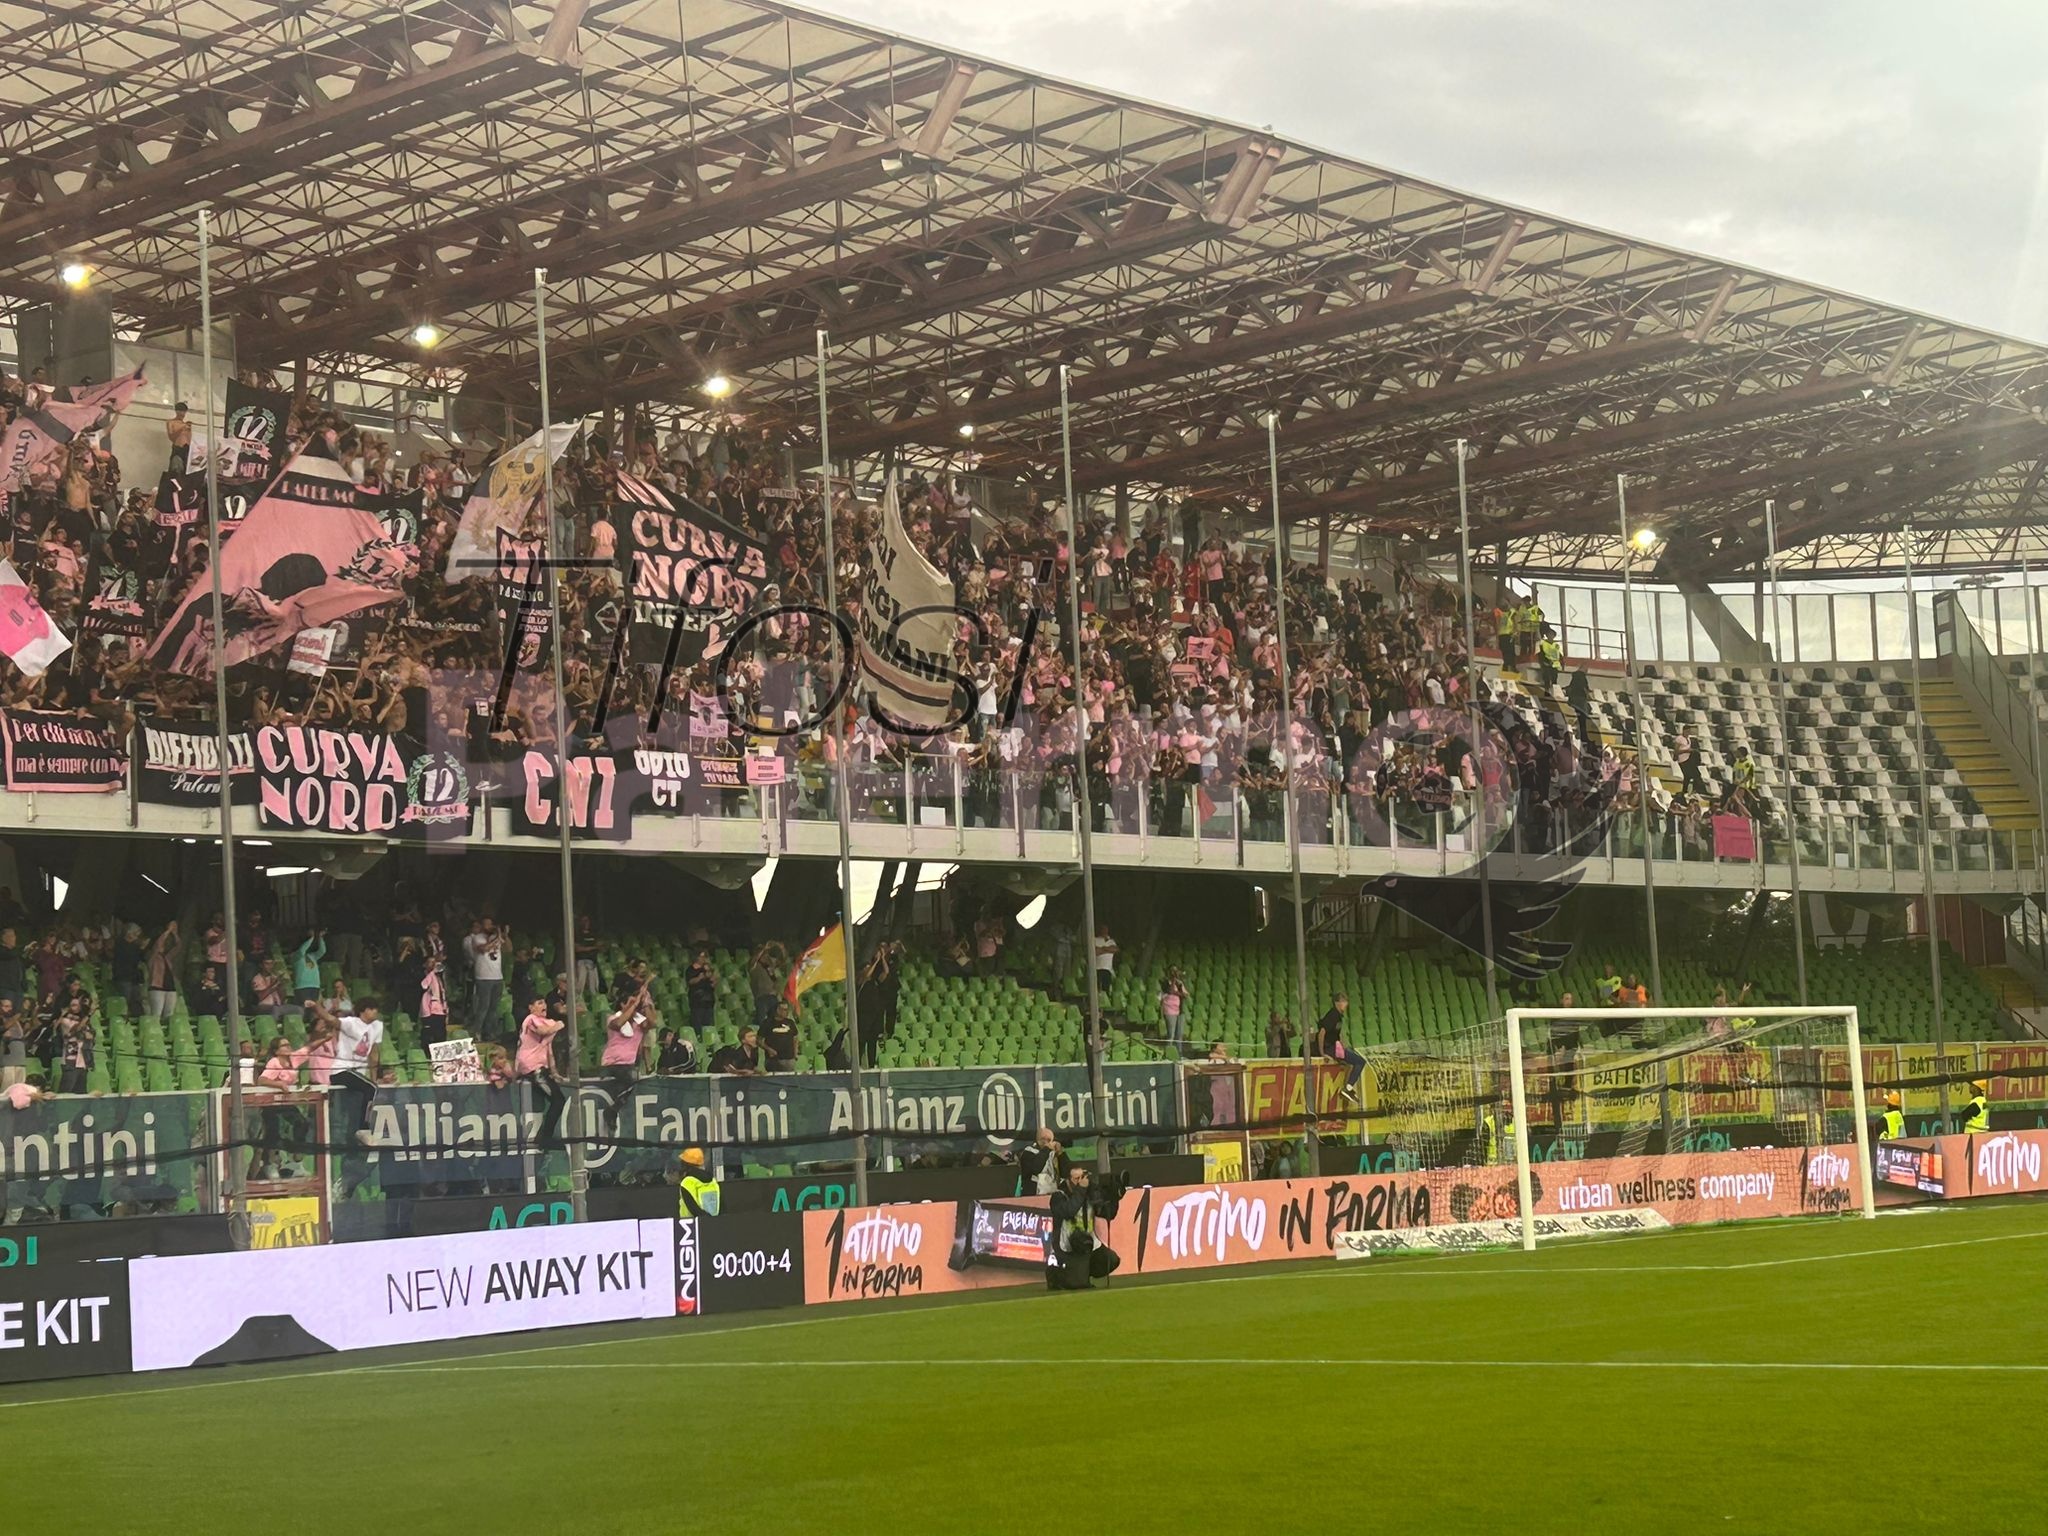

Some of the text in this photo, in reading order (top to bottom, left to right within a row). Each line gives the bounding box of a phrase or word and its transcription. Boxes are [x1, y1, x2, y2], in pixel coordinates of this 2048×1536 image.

[631, 510, 767, 579] CURVA
[257, 726, 408, 784] CURVA
[634, 751, 691, 779] ODIO
[259, 775, 397, 832] NORD
[423, 768, 454, 801] 12
[652, 779, 682, 807] CT
[635, 1088, 789, 1143] Fantini
[830, 1086, 967, 1135] Allianz
[1038, 1077, 1159, 1129] Fantini
[0, 1111, 157, 1182] ntini
[366, 1102, 544, 1163] Allianz
[1558, 1170, 1776, 1211] urban wellness company
[386, 1251, 654, 1315] NEW AWAY KIT
[712, 1248, 792, 1279] 90:00+4
[36, 1296, 110, 1347] KIT
